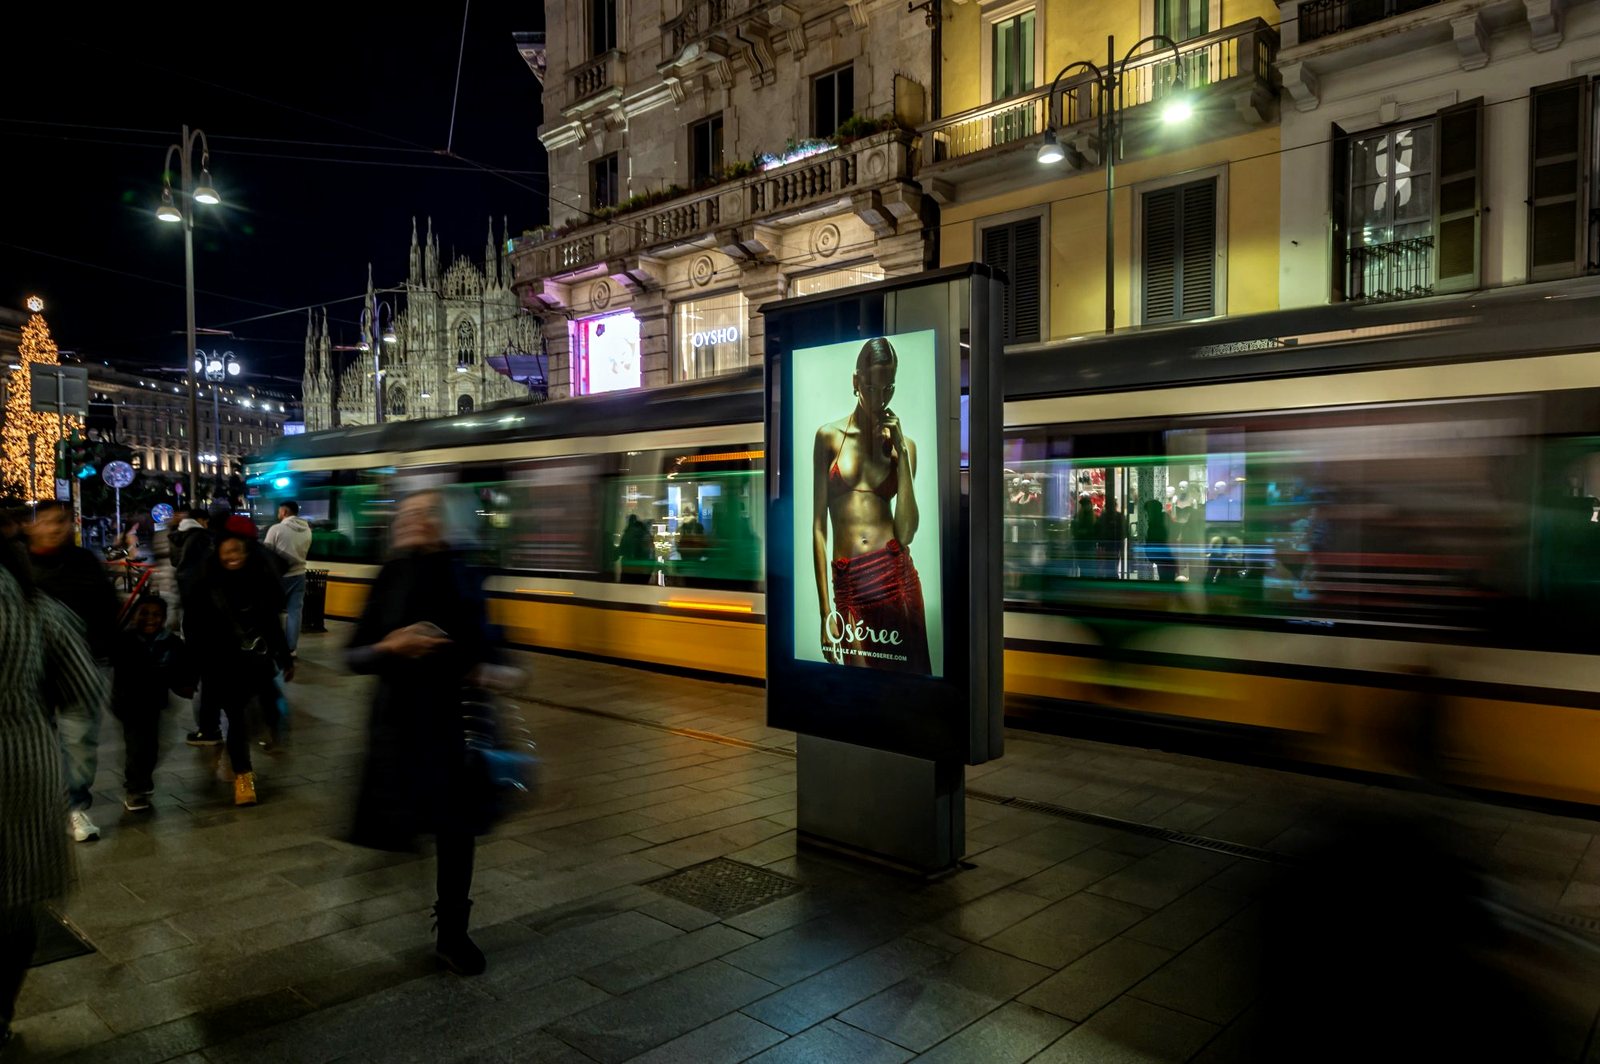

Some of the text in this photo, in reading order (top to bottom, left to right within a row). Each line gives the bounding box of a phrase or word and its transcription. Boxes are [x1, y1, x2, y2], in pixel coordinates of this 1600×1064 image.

[694, 327, 738, 347] OYSHO
[823, 646, 849, 654] AVAIALE
[858, 651, 907, 661] WWW.OSEREE.COM
